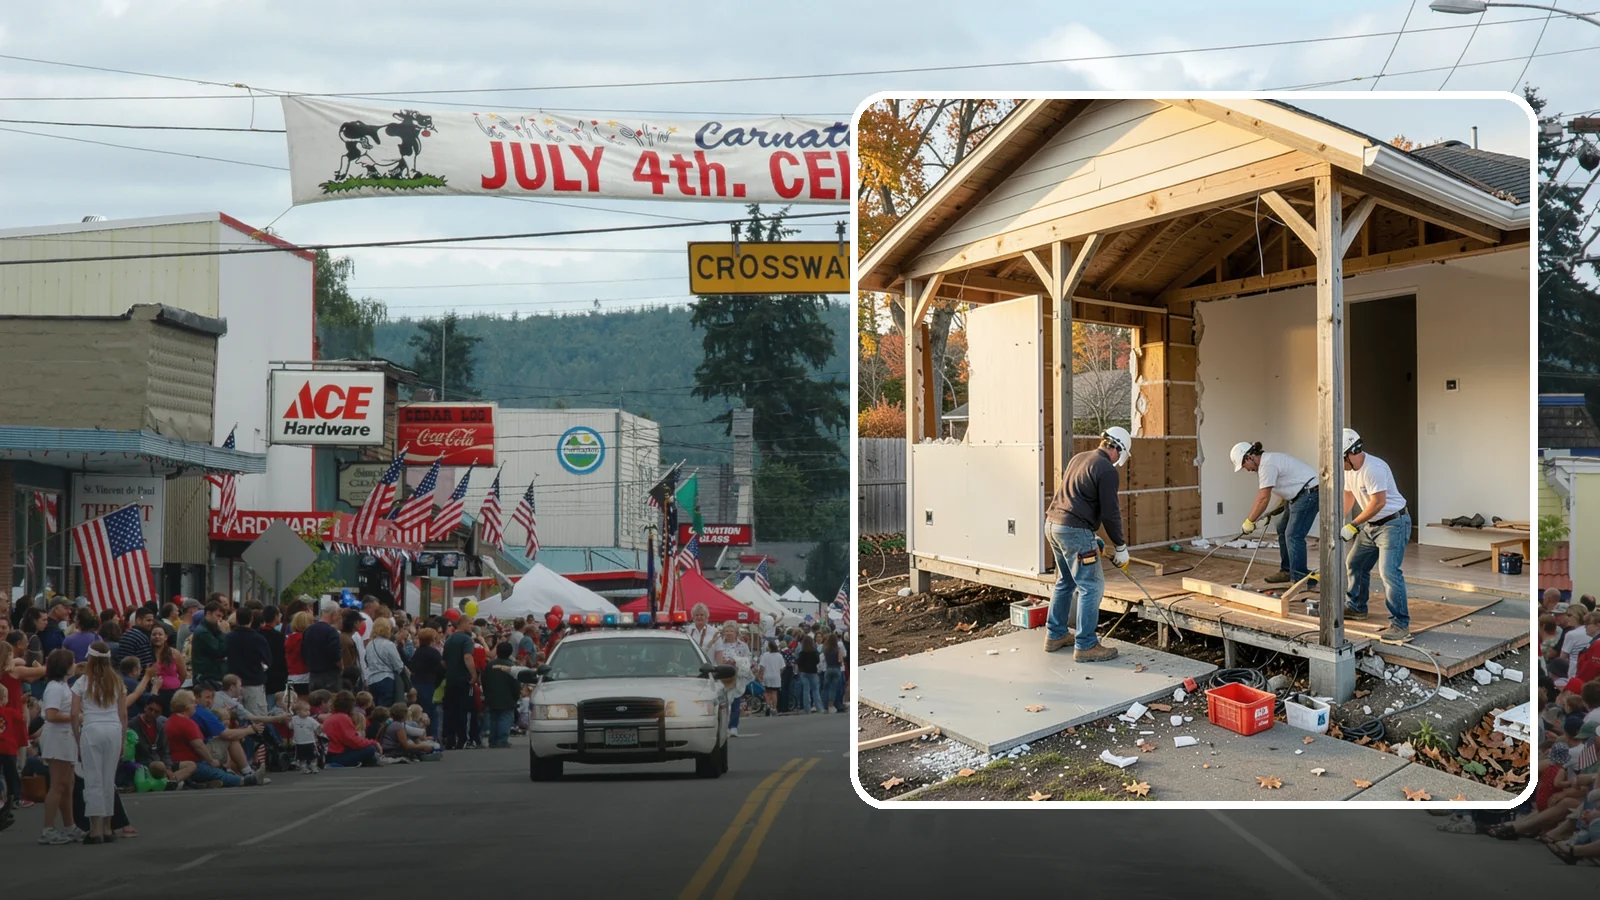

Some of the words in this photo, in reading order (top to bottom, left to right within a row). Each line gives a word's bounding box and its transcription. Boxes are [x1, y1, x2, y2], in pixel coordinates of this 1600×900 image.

[481, 140, 605, 192] JULY
[631, 149, 747, 198] 4th.
[697, 254, 850, 280] CROSSWA
[282, 379, 374, 420] ACE
[406, 409, 452, 422] CEDAR
[461, 409, 485, 422] LOG
[283, 421, 371, 437] Hardware
[416, 428, 478, 447] Coca-Cola
[353, 467, 385, 481] Simpl
[95, 484, 124, 495] Vincent
[126, 485, 135, 495] de
[137, 486, 155, 495] Paul
[80, 503, 154, 522] THT
[212, 515, 330, 534] HARDARE
[688, 526, 741, 535] CRNATION
[699, 535, 730, 543] GLASS
